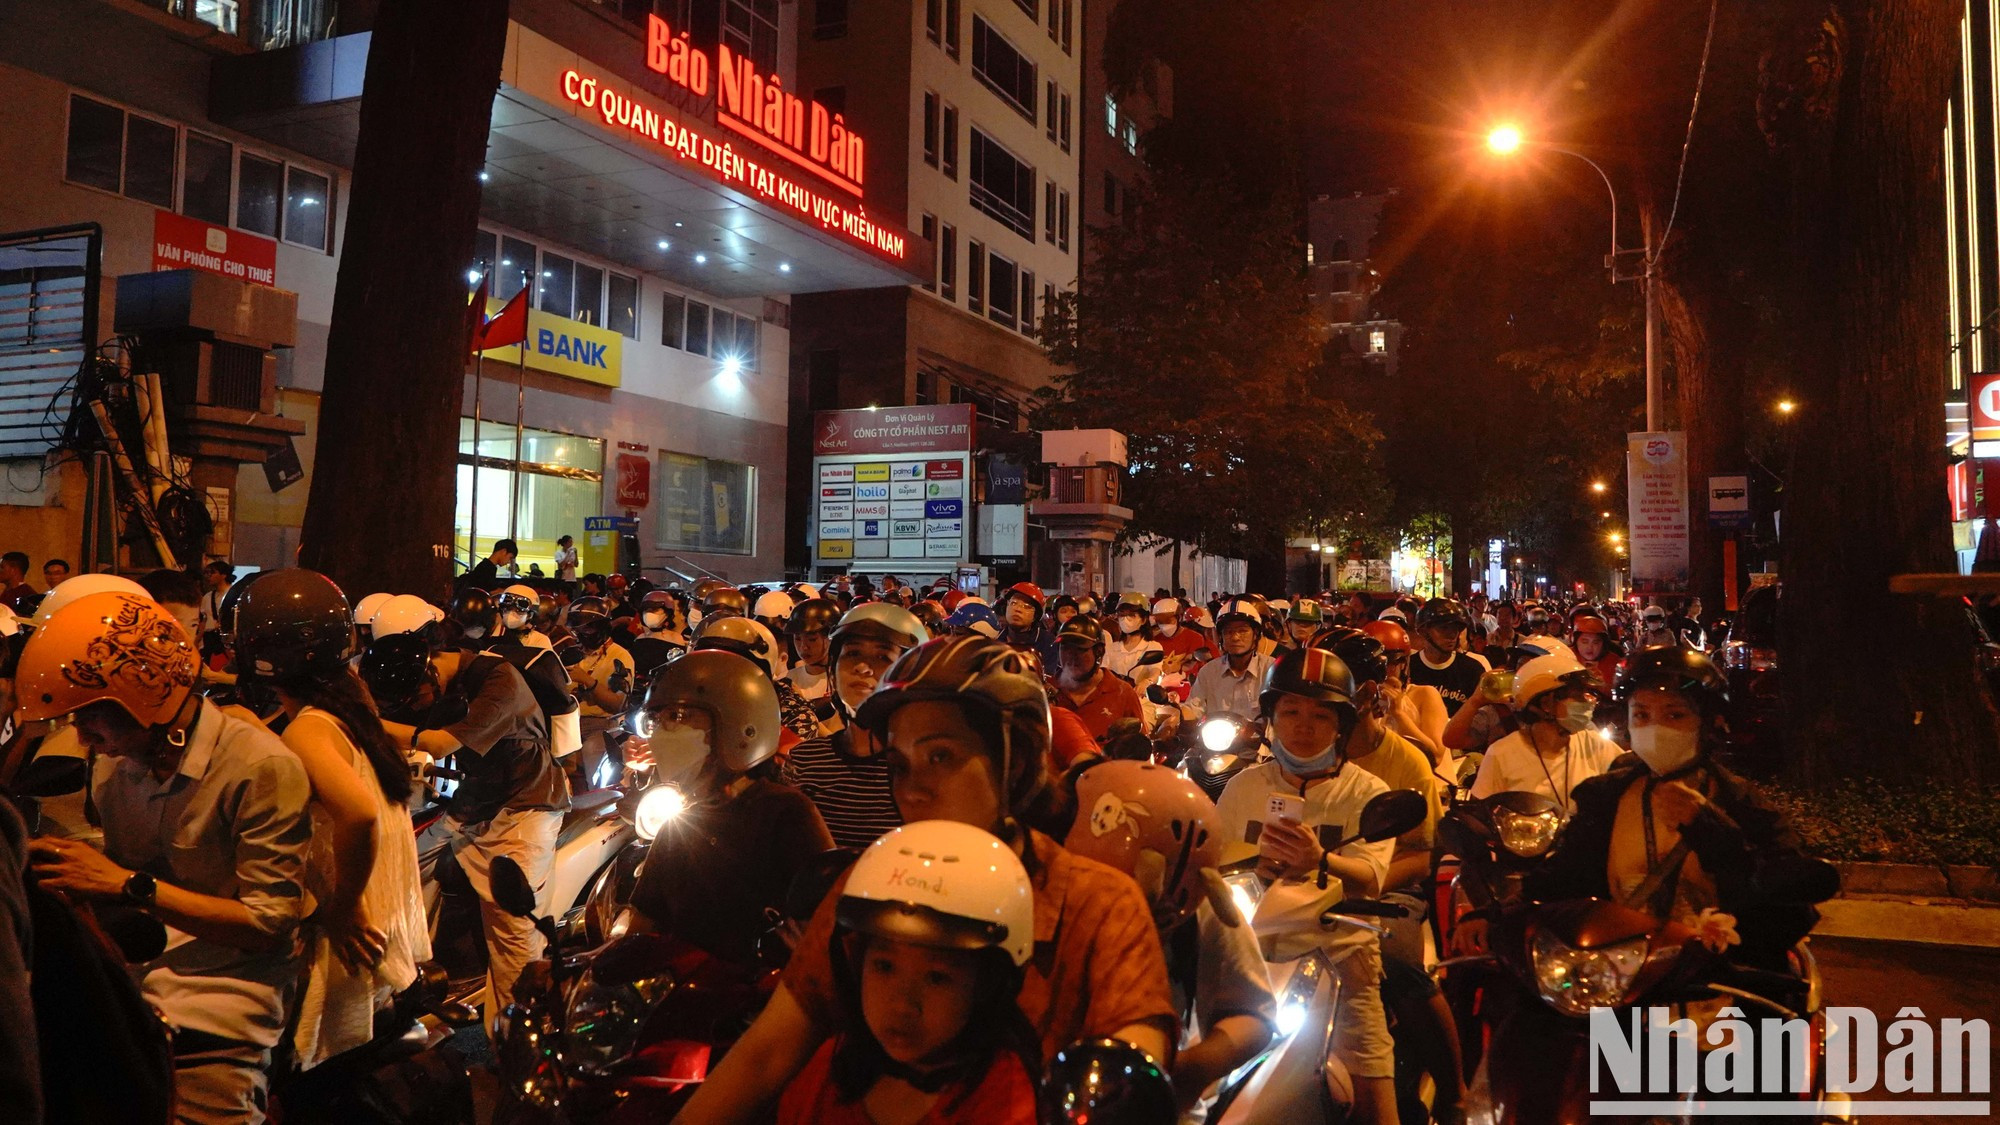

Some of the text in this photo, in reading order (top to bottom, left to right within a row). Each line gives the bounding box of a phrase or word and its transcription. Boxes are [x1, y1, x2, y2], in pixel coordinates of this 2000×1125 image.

[647, 12, 864, 184] Báo Nhân Dân
[564, 71, 904, 258] CƠ QUAN ĐẠI DIỆN TẠI KHU VỰC MIỀN NAM
[157, 243, 273, 283] VĂN PHÒNG CHO THUÊ
[538, 328, 608, 369] BANK
[885, 414, 899, 423] Đơn
[900, 414, 907, 424] Vị
[927, 414, 935, 423] Lý
[853, 428, 877, 439] CÔNG
[878, 427, 888, 438] TY
[928, 425, 949, 435] NEST
[950, 424, 968, 434] ART
[1003, 476, 1021, 487] spa
[619, 489, 646, 500] Nest Art
[931, 504, 957, 512] vivo
[589, 519, 611, 529] ATM
[982, 523, 1018, 533] VICHY
[822, 526, 851, 534] Cominix
[432, 544, 450, 559] 116
